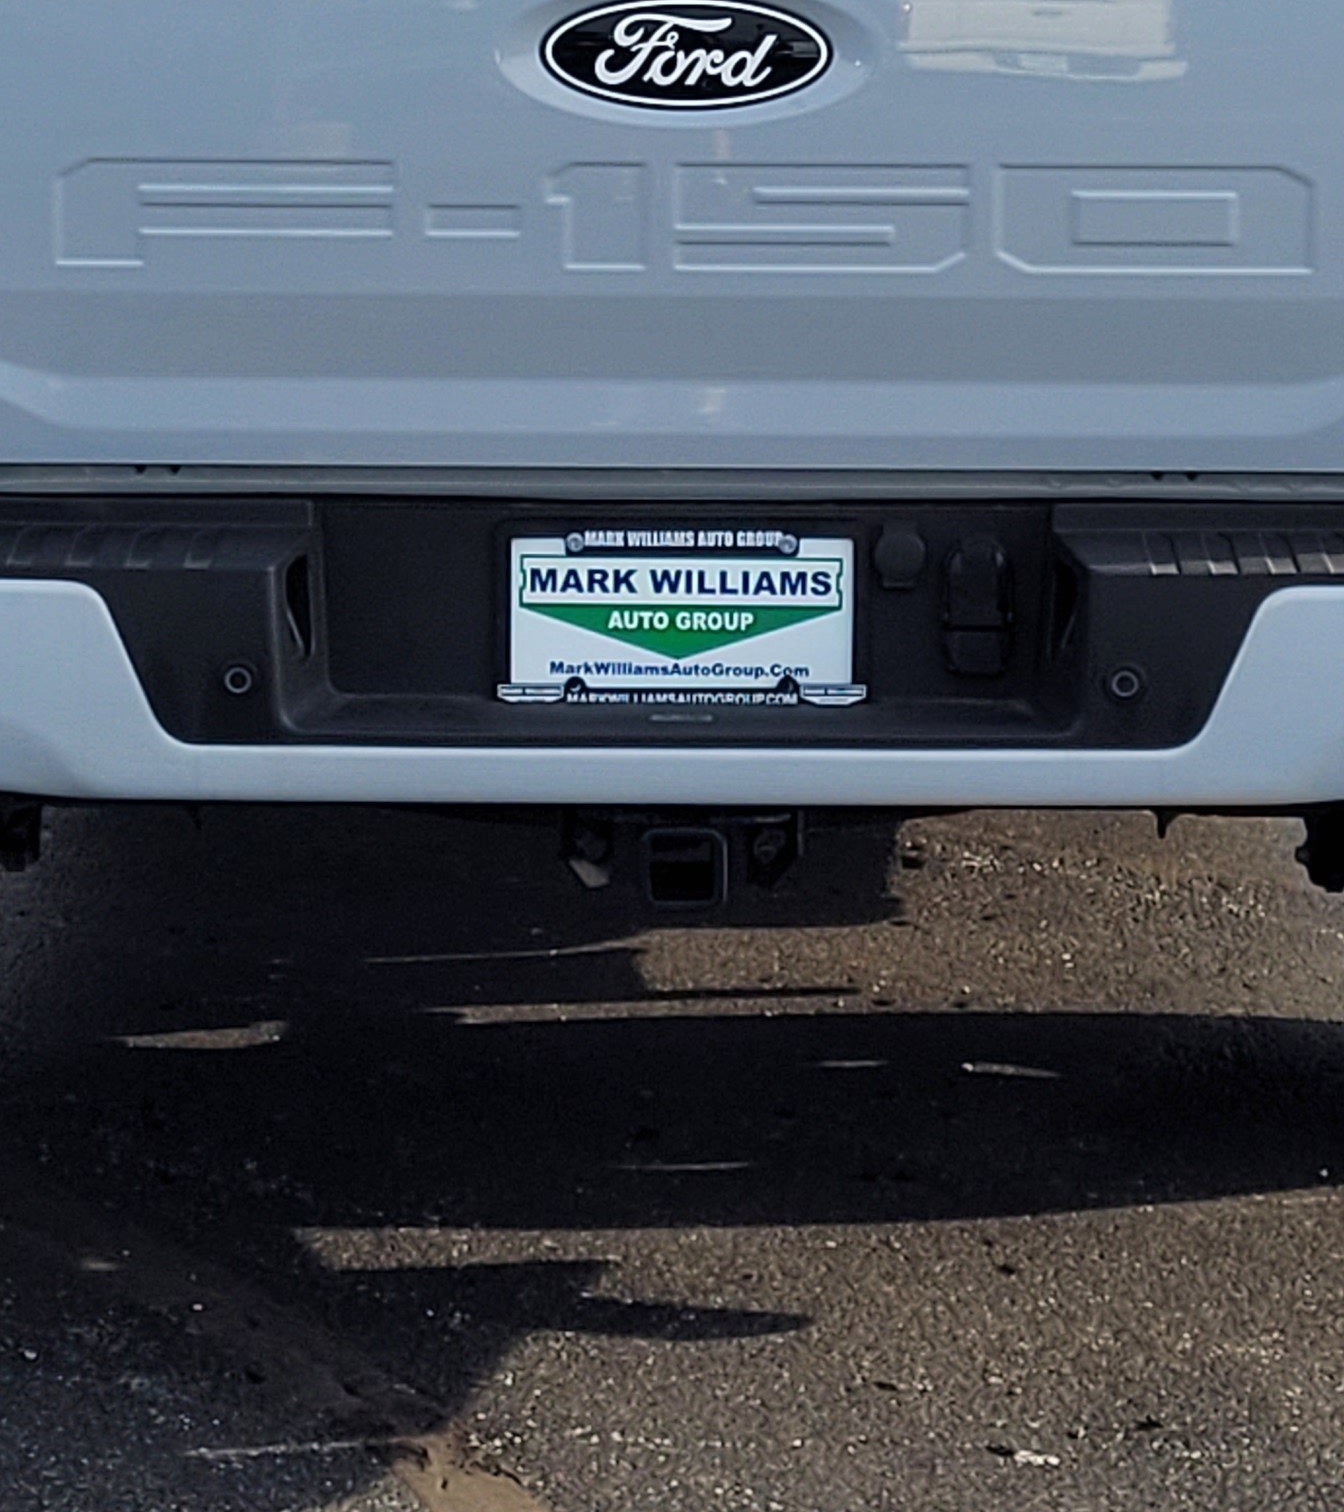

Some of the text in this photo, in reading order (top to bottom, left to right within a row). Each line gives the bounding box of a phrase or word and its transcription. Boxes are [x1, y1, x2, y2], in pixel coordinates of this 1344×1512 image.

[594, 13, 777, 87] Ford
[56, 157, 1314, 276] F-150
[584, 531, 625, 547] MARK
[627, 531, 695, 547] WILLIAMS
[697, 531, 734, 547] AUTO
[529, 568, 832, 595] MARK WILLIAMS
[607, 611, 754, 631] AUTO GROUP
[549, 661, 810, 678] MarkWilliamsAutoGroup.Com
